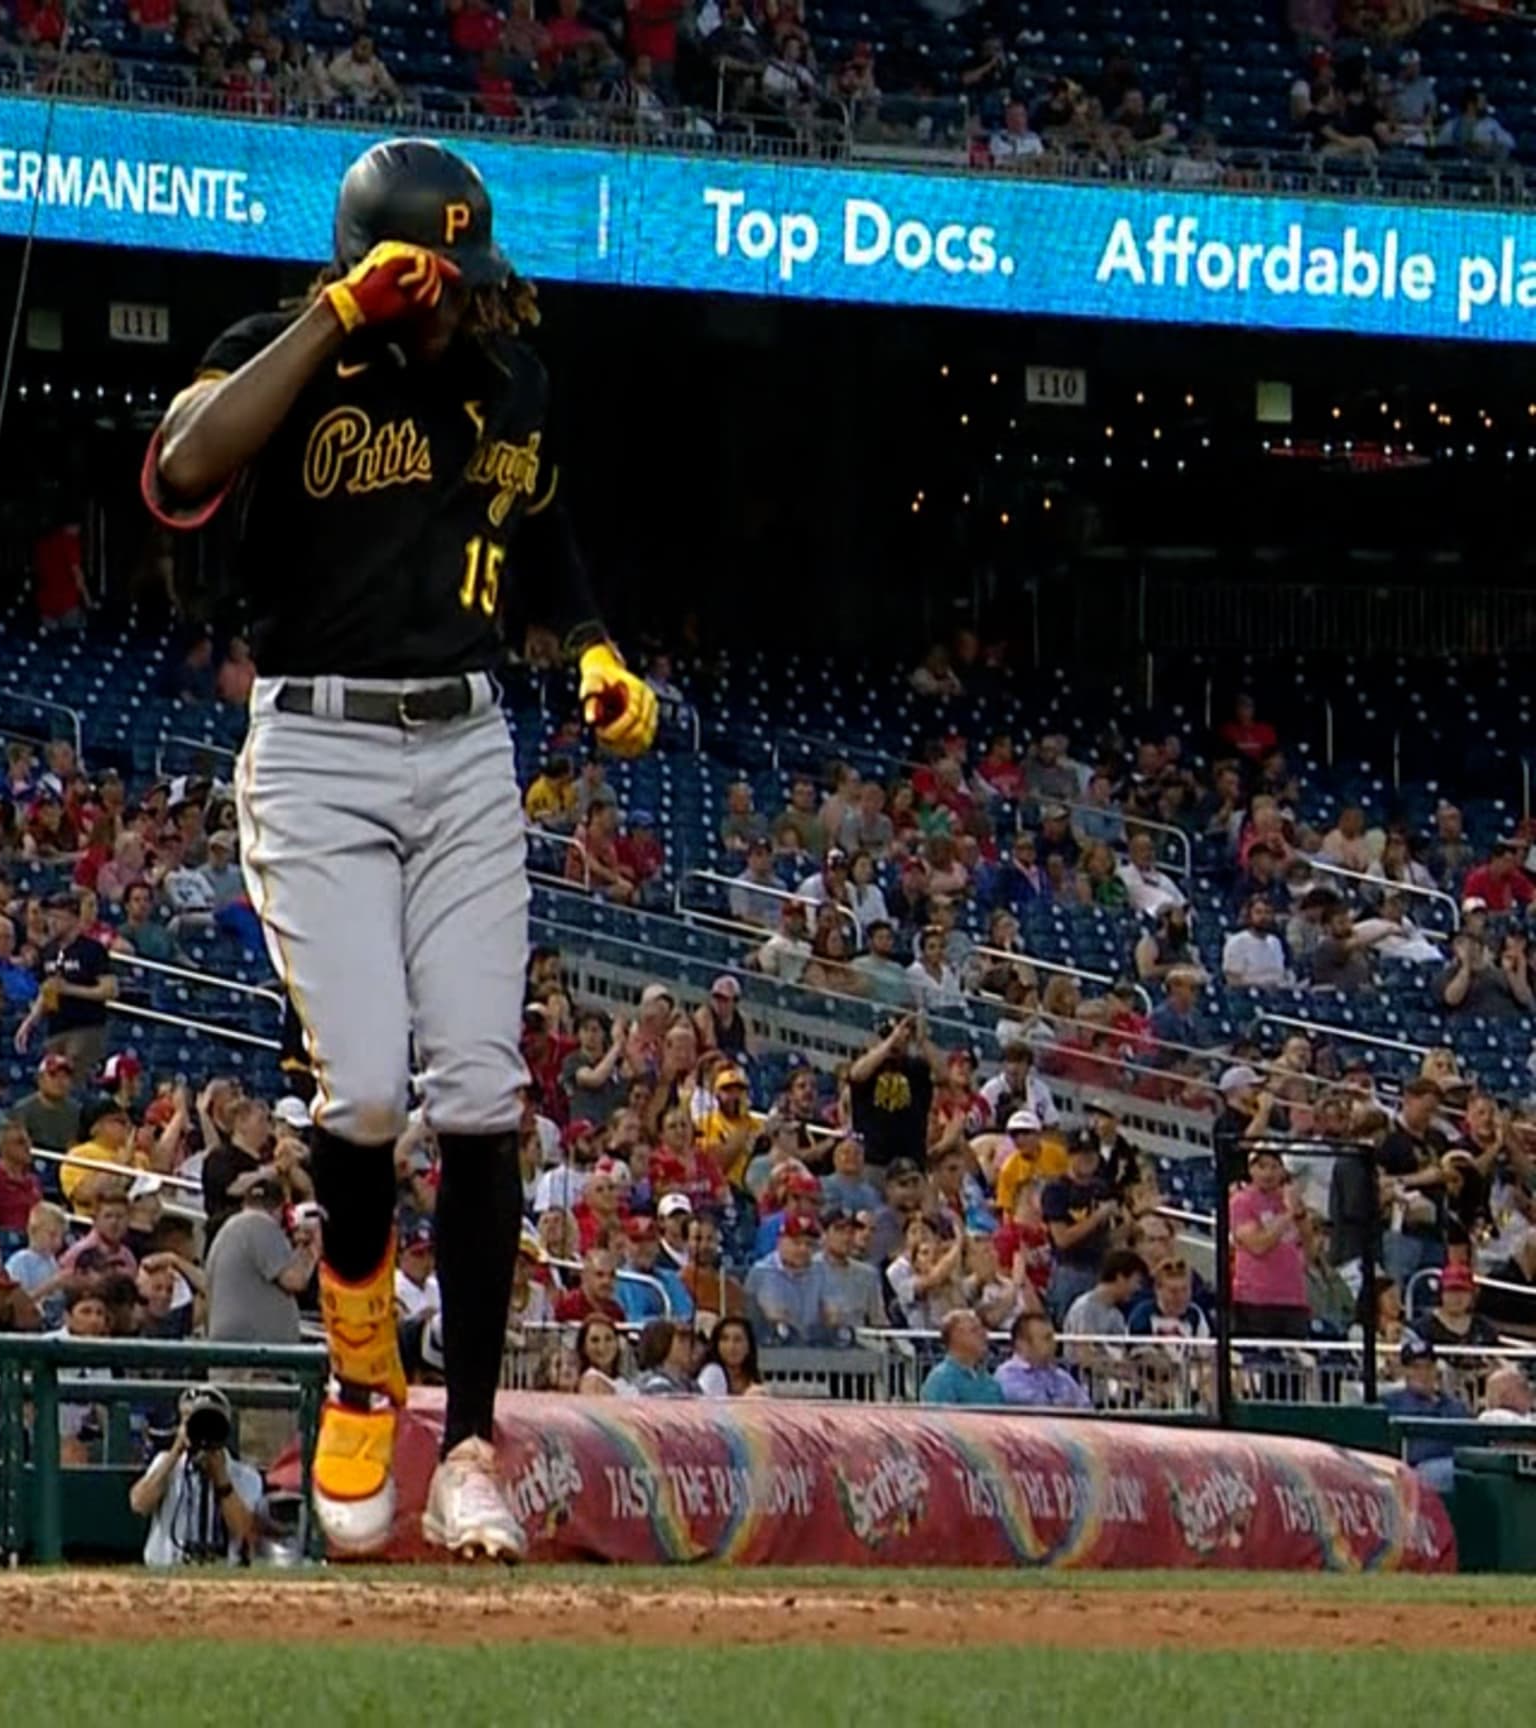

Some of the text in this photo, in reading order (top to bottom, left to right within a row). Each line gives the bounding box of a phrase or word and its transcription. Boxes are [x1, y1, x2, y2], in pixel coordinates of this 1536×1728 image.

[445, 203, 471, 244] P
[703, 186, 1015, 281] Top Docs.
[1095, 214, 1436, 301] Affordable
[123, 309, 158, 337] 111
[1037, 372, 1077, 399] 110
[303, 401, 543, 527] Pittsurgh
[460, 536, 505, 615] 15
